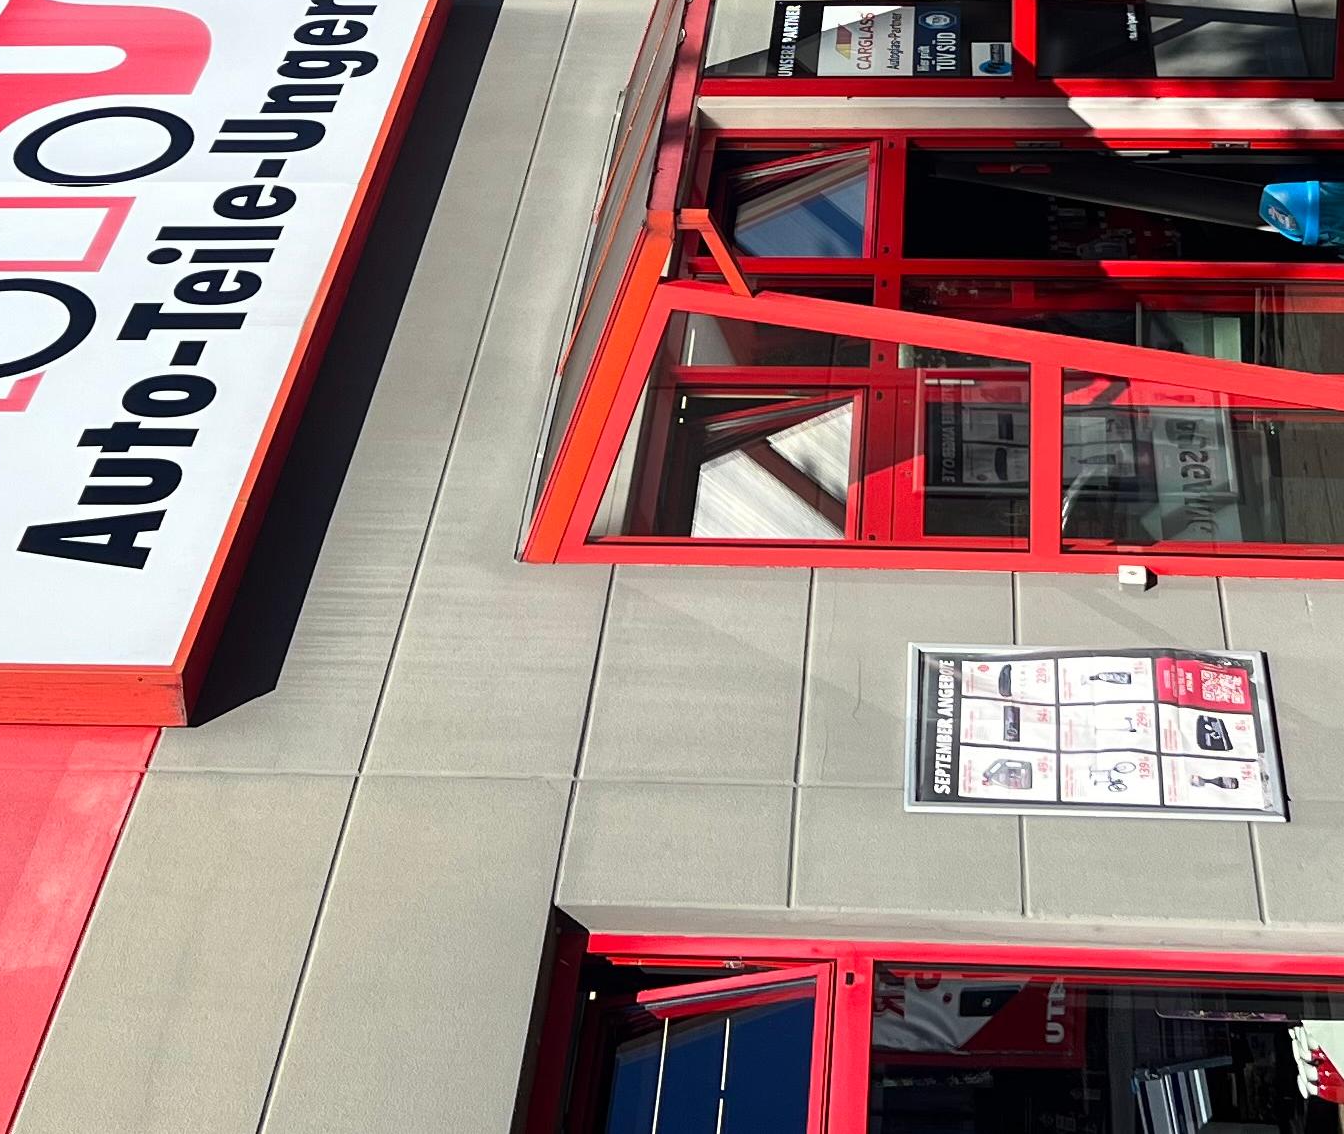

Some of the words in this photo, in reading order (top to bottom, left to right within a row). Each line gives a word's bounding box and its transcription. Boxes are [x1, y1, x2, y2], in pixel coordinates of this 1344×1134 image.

[782, 4, 801, 42] PARTNER
[886, 12, 904, 70] Autoglas-Partner
[932, 32, 956, 52] SÜD
[778, 44, 796, 76] UNSERE
[932, 52, 956, 71] TÜV
[937, 660, 954, 717] ANGEBOTE
[934, 717, 954, 794] SEPTEMBER
